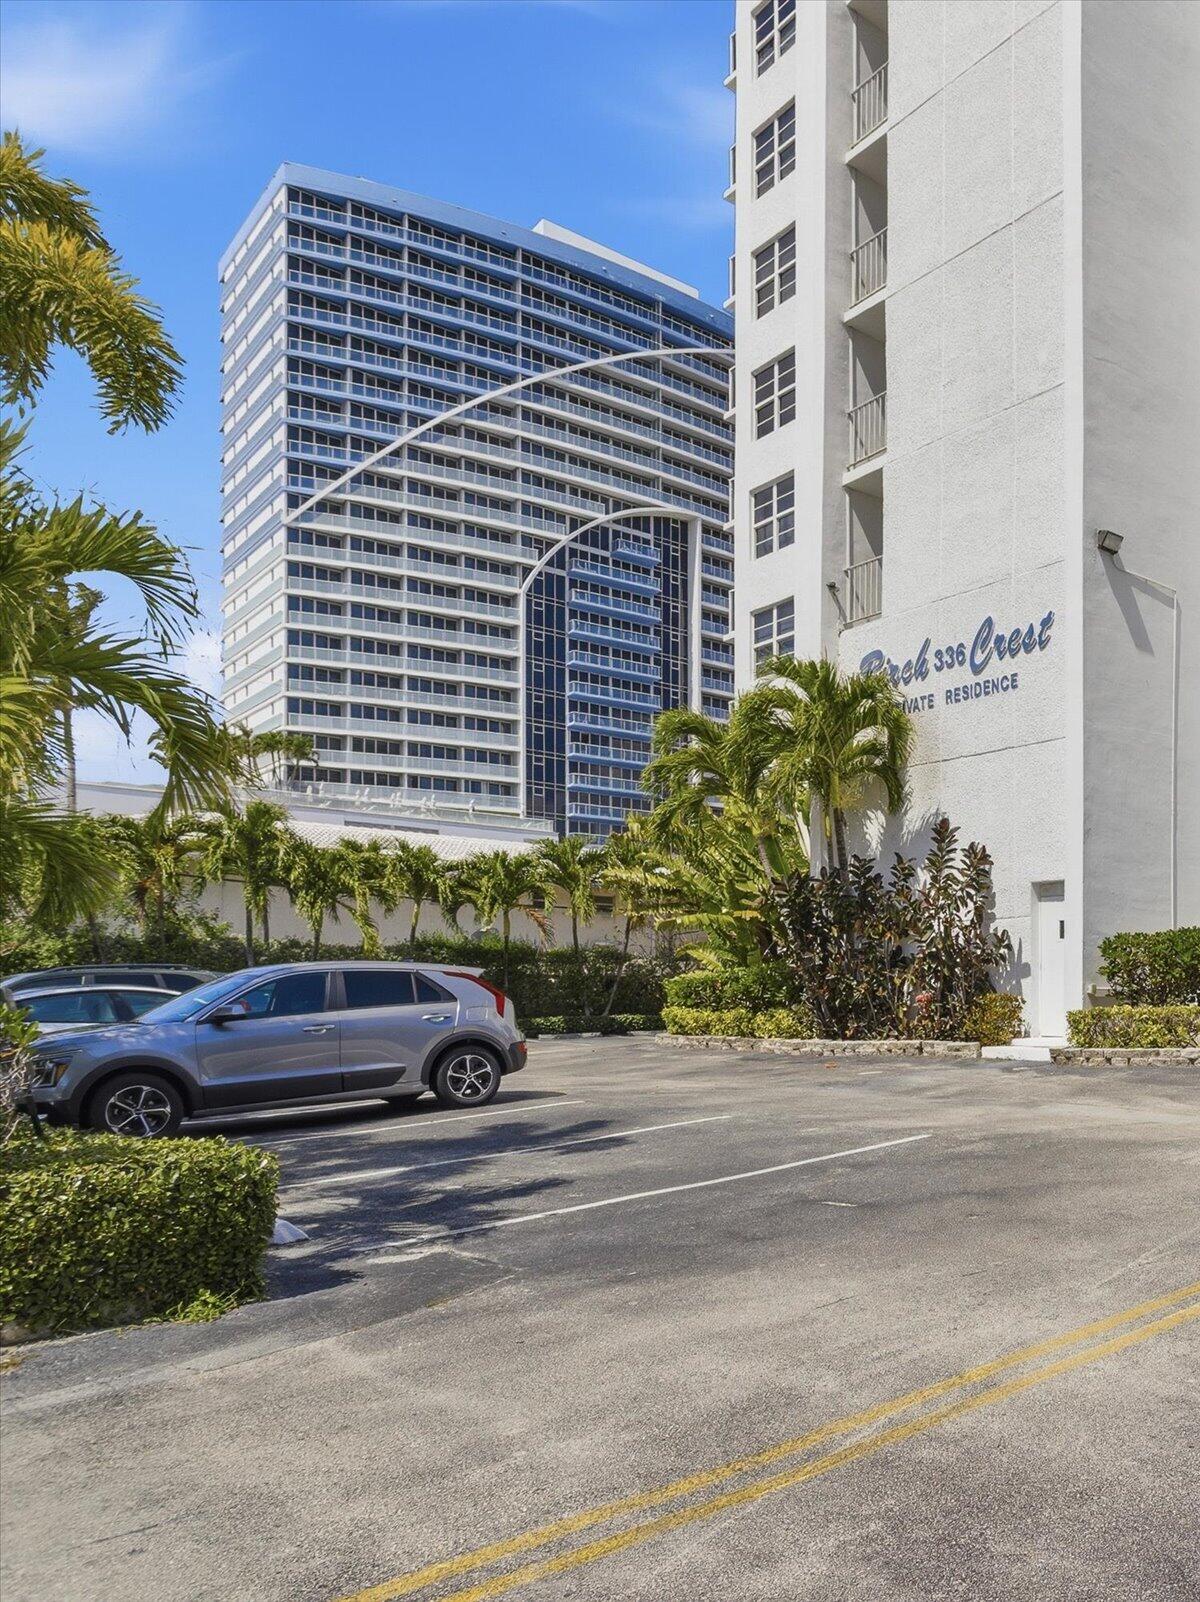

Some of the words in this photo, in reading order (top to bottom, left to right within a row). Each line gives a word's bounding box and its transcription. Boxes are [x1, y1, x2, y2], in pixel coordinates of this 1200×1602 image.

[933, 642, 966, 672] 336
[969, 610, 1055, 676] Crest
[895, 693, 935, 714] IVATE
[945, 672, 1019, 705] RESIDENCE
